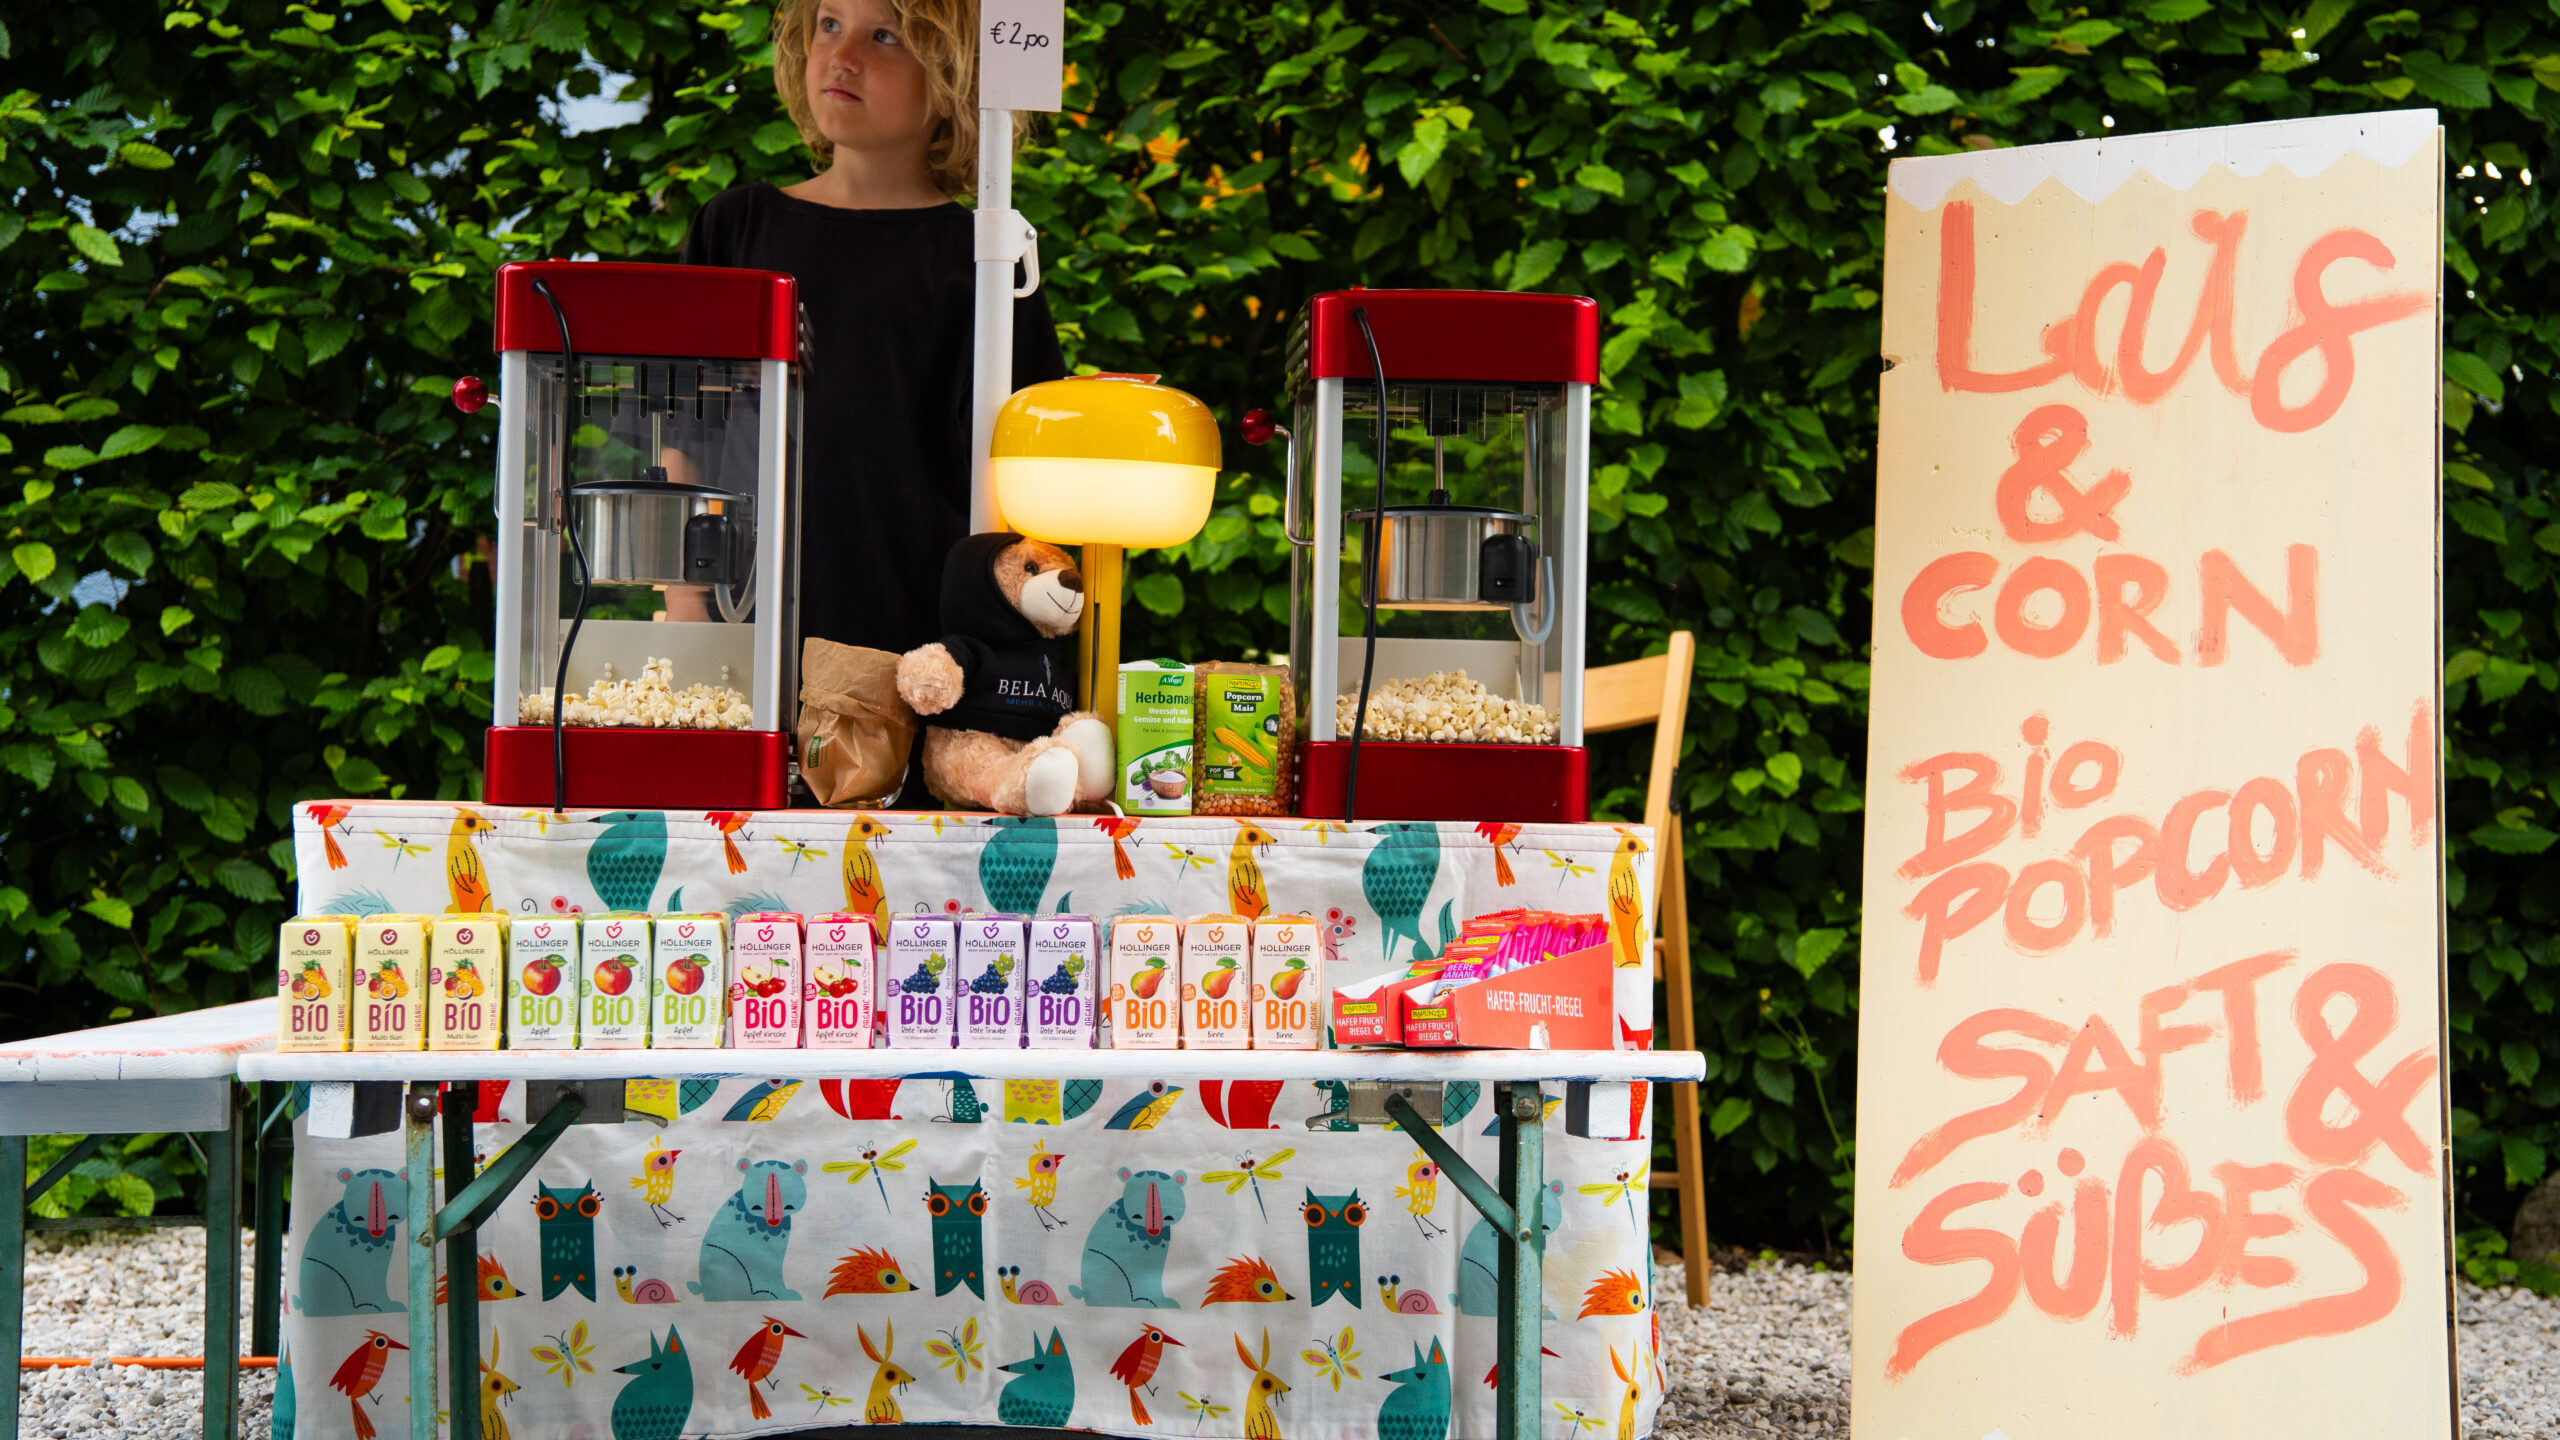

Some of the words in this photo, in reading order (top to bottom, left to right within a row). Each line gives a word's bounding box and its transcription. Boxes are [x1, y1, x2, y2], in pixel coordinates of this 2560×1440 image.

[1996, 404, 2132, 543] &
[1901, 543, 2320, 667] CORN
[998, 679, 1047, 698] BELA
[1226, 691, 1262, 701] Popcorn
[1233, 704, 1255, 712] Mais
[1899, 696, 2435, 988] POPCORN
[1486, 989, 1584, 1018] HAFER-FRUCHT-RIEGEL
[1343, 1004, 1377, 1014] RAPUNZEL
[1412, 1009, 1447, 1018] RAPUNZEL
[1336, 1018, 1358, 1026] HAFER
[1359, 1017, 1384, 1025] FRUCHT
[531, 1027, 551, 1035] Apfel
[602, 1027, 621, 1035] Apfel
[673, 1026, 693, 1035] Apfel
[901, 1026, 915, 1034] Rote
[916, 1026, 938, 1034] Traube
[970, 1026, 984, 1034] Rote
[985, 1026, 1007, 1034] Traube
[1040, 1026, 1054, 1035] Rote
[1055, 1027, 1077, 1035] Traube
[1349, 1027, 1372, 1036] RIEGEL
[1406, 1023, 1427, 1032] HAFER
[1428, 1022, 1454, 1031] FRUCHT
[743, 1030, 763, 1040] Apfel
[764, 1030, 787, 1038] Kirsche
[815, 1030, 835, 1040] Apfel
[836, 1030, 859, 1038] Kirsche
[1276, 1031, 1293, 1039] Birne
[1418, 1032, 1441, 1041] RIEGEL
[1887, 947, 2301, 1190] SAFT
[2282, 961, 2438, 1179] &
